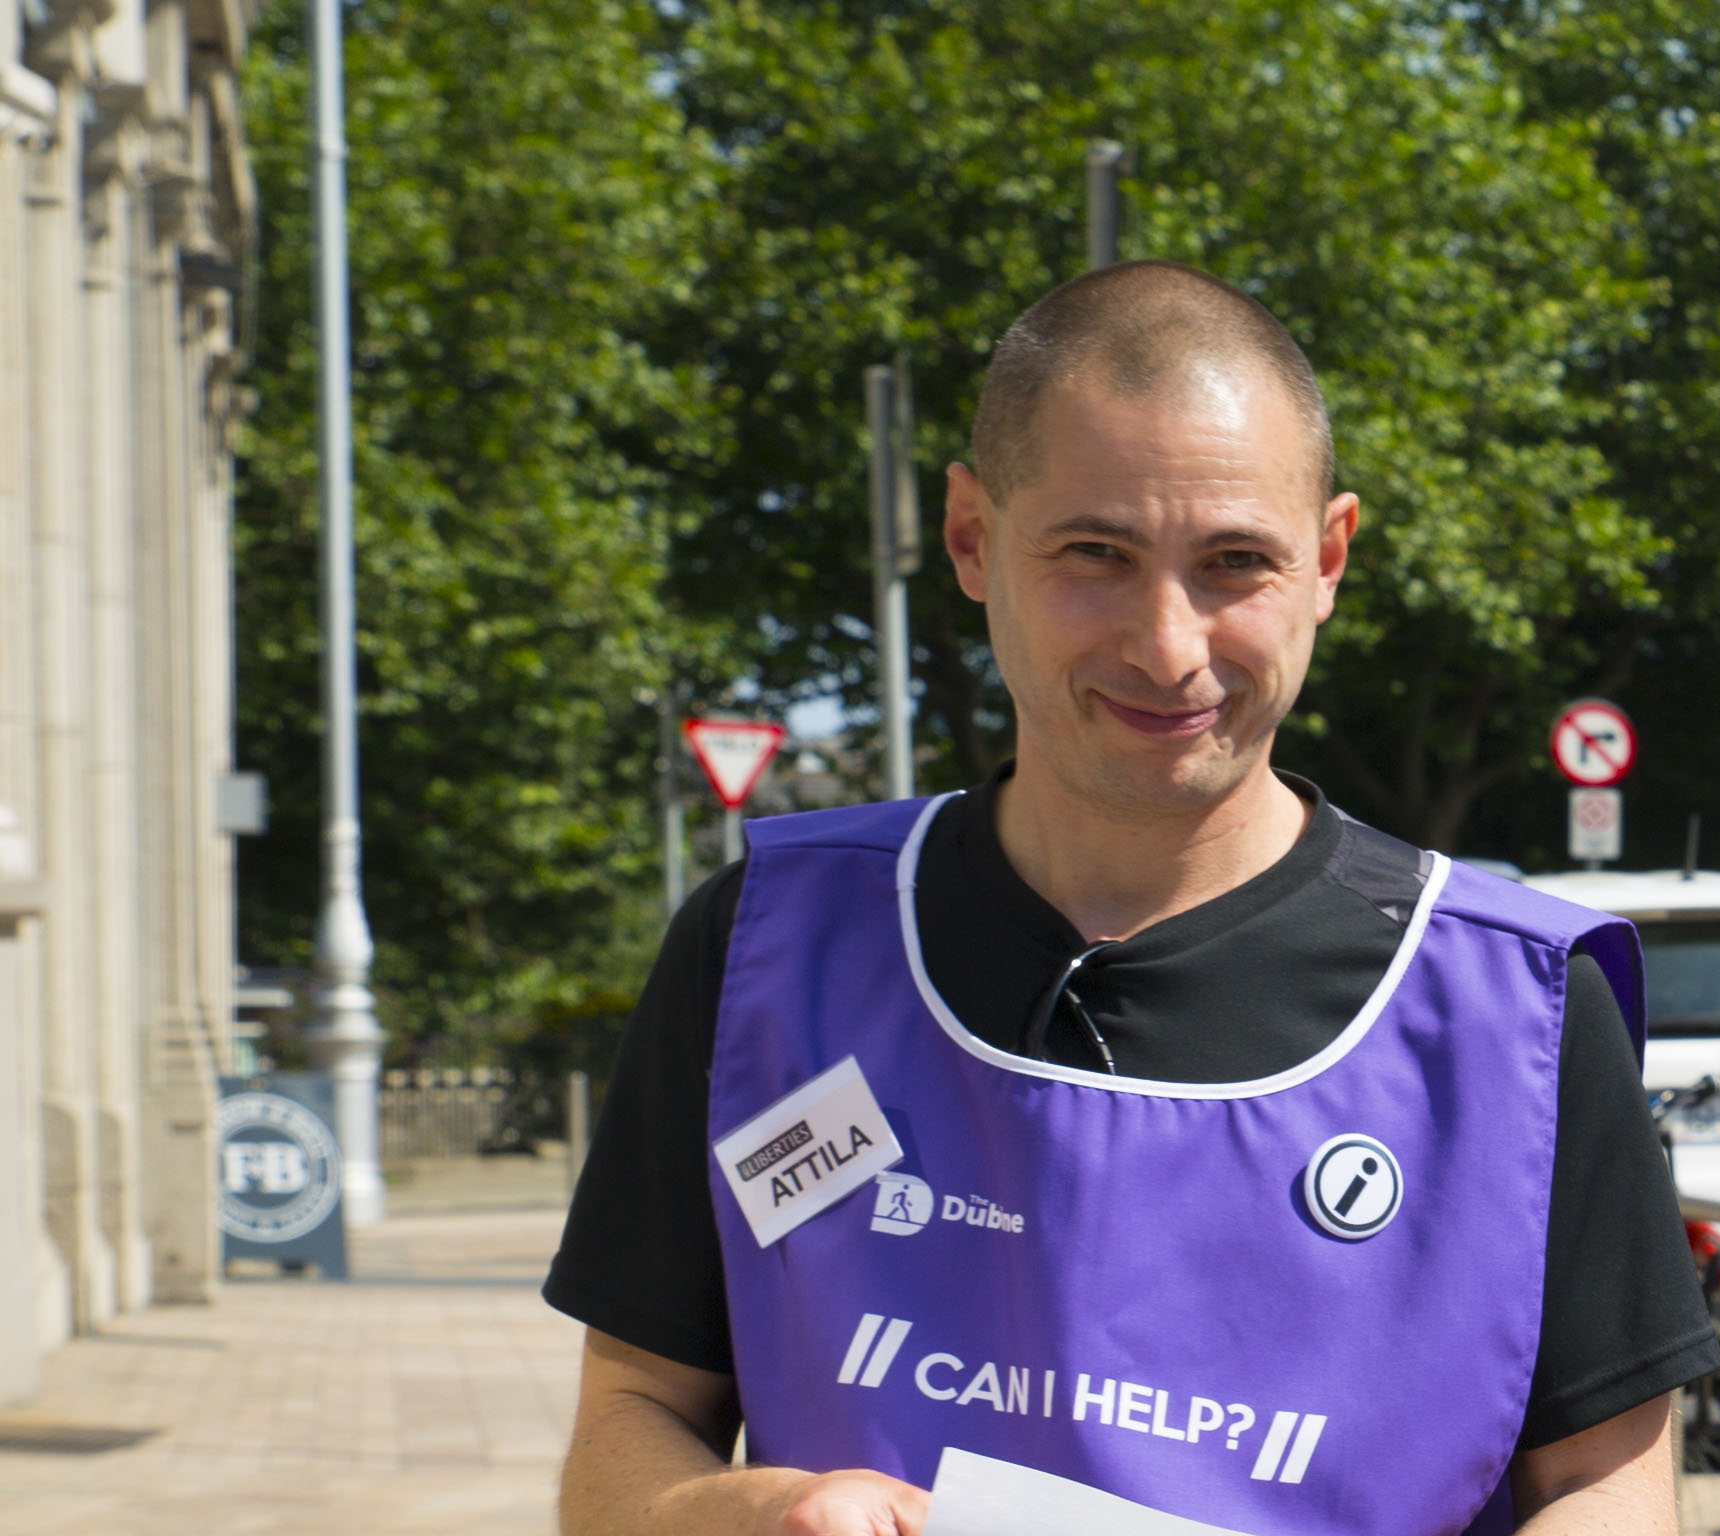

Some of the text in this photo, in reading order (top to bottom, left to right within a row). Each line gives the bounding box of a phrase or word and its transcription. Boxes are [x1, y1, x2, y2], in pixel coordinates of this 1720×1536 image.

[745, 1124, 810, 1176] LIBERTIES
[771, 1124, 874, 1208] ATTILA
[914, 1352, 1256, 1451] CAN I HELP?
